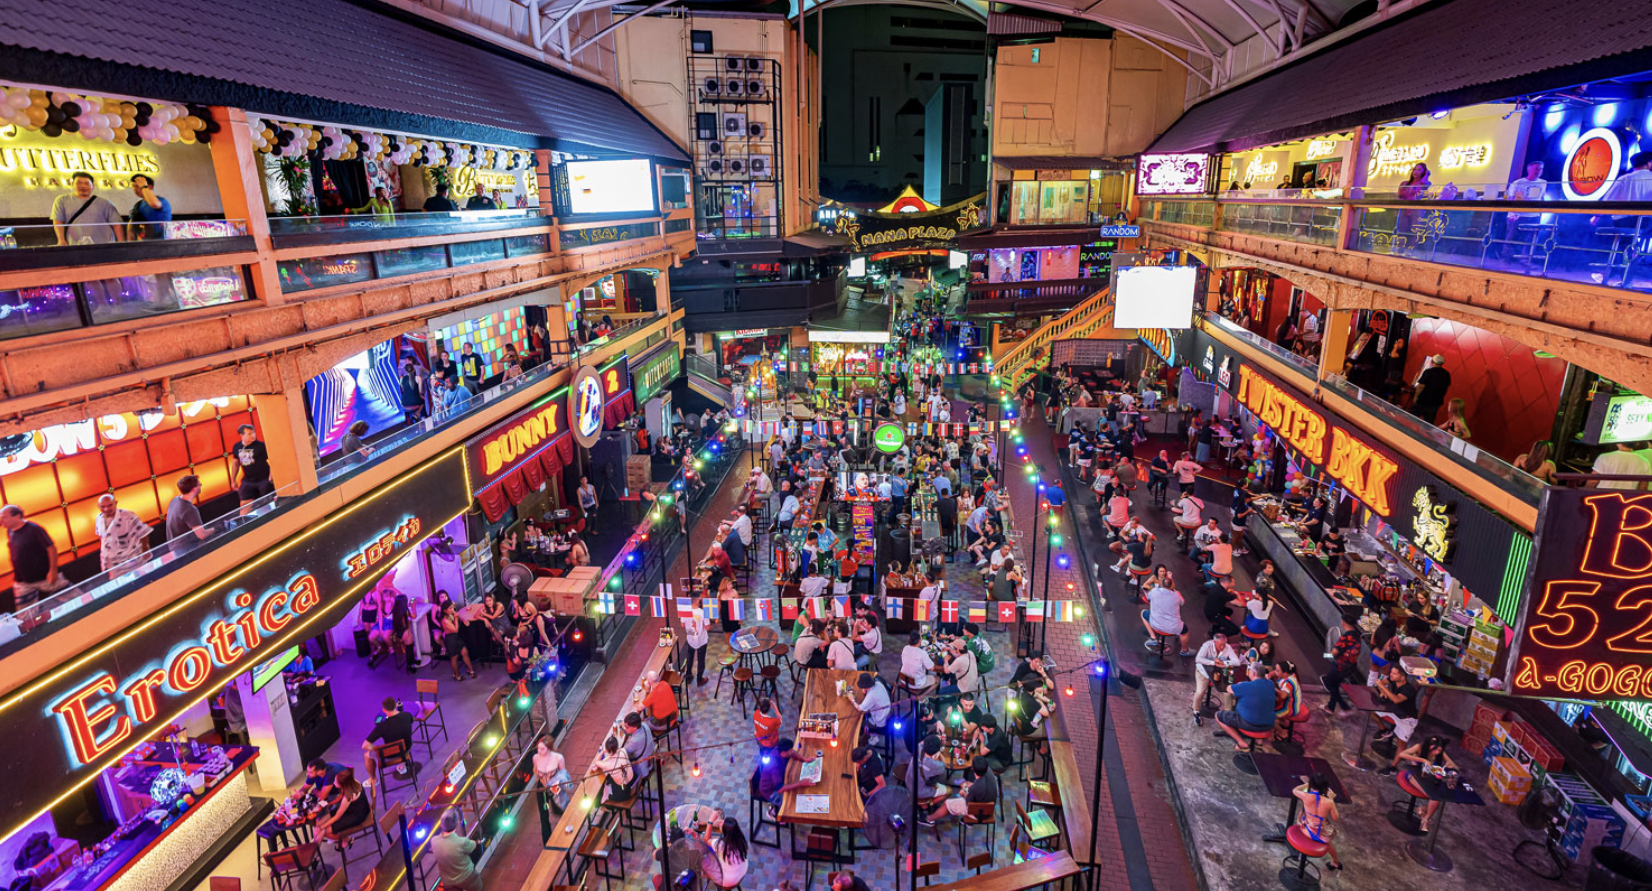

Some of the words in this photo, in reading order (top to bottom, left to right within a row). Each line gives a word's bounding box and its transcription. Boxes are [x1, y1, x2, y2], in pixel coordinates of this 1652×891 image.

[861, 228, 908, 247] NANA
[908, 225, 957, 241] PLAZA
[1080, 252, 1112, 261] RANDO
[1103, 227, 1138, 236] RANDOM
[606, 369, 619, 394] 2
[483, 402, 559, 476] BUNNY
[1238, 362, 1327, 466] TWISTER
[1325, 425, 1399, 517] BKK
[346, 512, 421, 579] エロティカ
[1579, 492, 1652, 580] B
[1528, 580, 1652, 655] 52
[50, 571, 321, 765] Erotica
